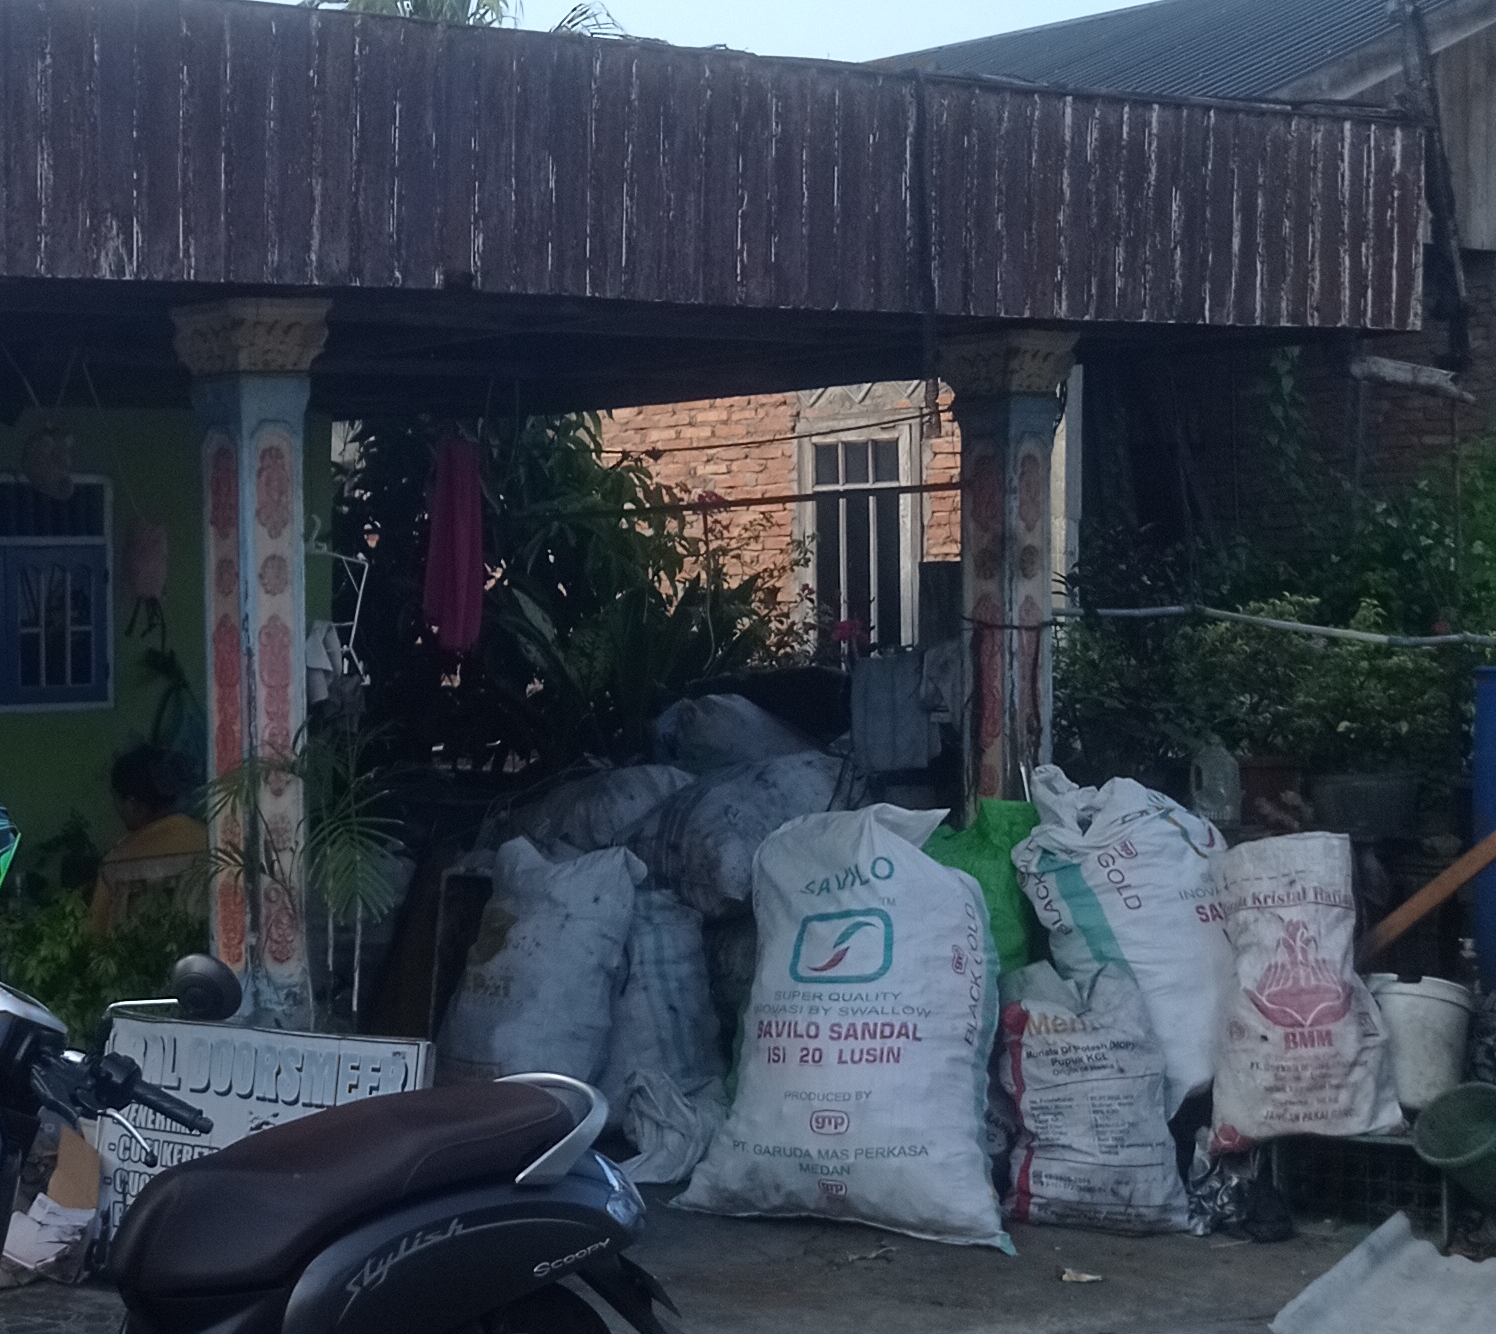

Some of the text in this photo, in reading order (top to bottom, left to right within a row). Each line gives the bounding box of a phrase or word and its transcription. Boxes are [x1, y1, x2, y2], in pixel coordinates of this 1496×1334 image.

[799, 856, 895, 897] SAVILO
[1097, 852, 1142, 910] GOLD
[1251, 884, 1307, 907] Kristal
[774, 990, 902, 1003] SUPER QUALITY
[808, 1005, 832, 1016] BY
[837, 1005, 932, 1018] SWALLOW
[964, 969, 982, 1046] BLACK
[757, 1019, 922, 1042] SAVILO SANDAL
[1283, 1028, 1334, 1049] BMM
[767, 1046, 902, 1065] ISI 20 LUSIN
[188, 1035, 410, 1108] DOORSMEER
[784, 1090, 872, 1102] PRODUCED BY
[754, 1143, 813, 1160] GARUDA
[817, 1148, 849, 1160] MAS
[854, 1144, 929, 1160] PERKASA
[799, 1162, 851, 1176] MEDAN
